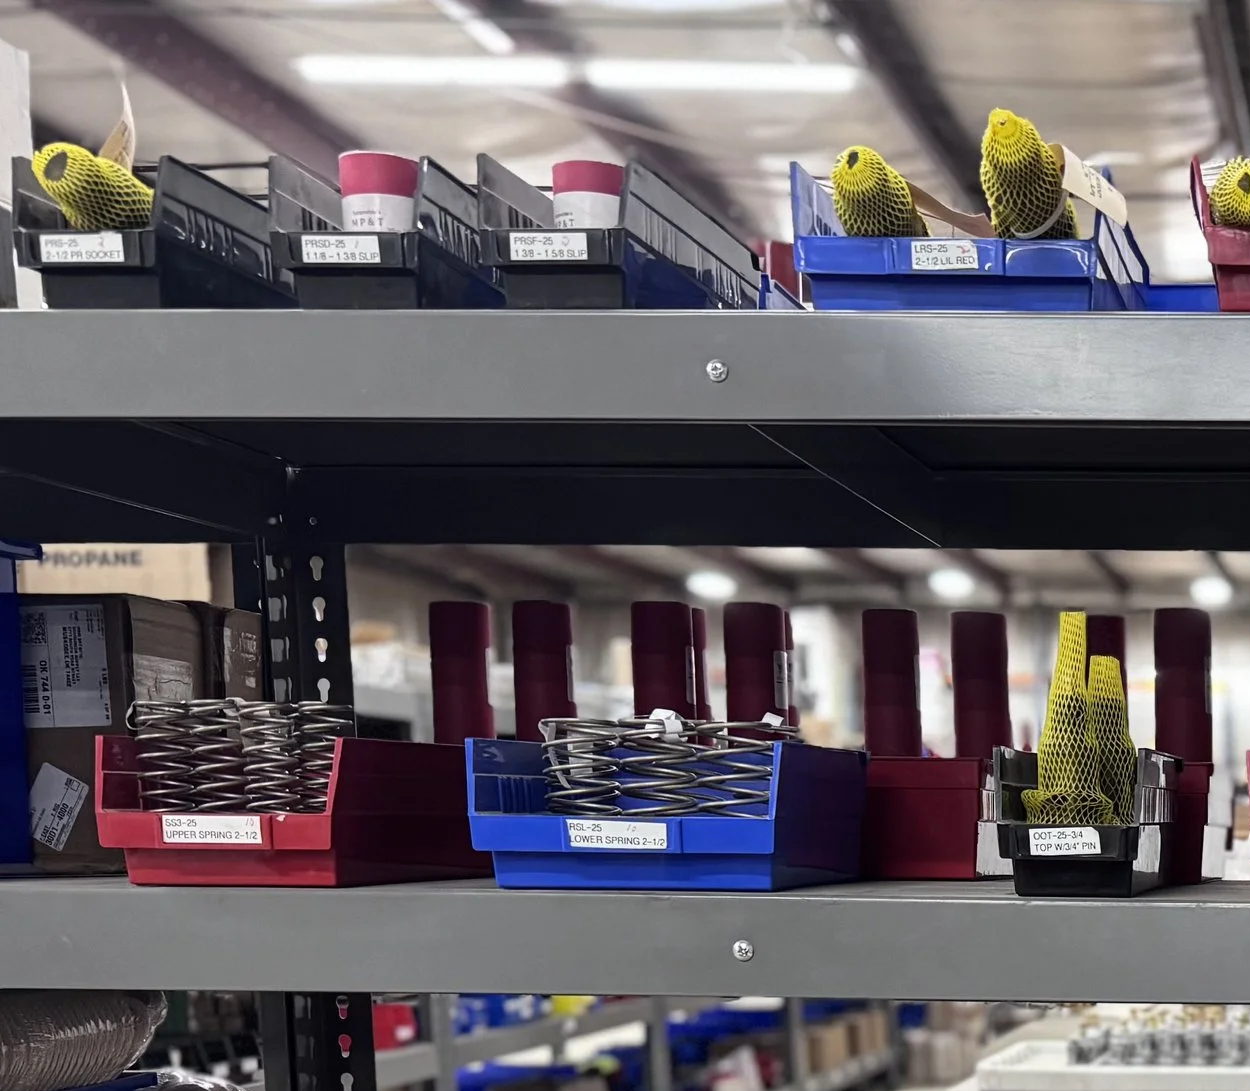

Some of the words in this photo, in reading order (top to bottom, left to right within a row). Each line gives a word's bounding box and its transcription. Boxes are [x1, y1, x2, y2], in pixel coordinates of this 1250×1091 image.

[44, 238, 79, 248] PRS-25
[304, 239, 346, 248] PRSD-25
[514, 236, 553, 246] PRSF-25
[566, 250, 586, 258] SLIP
[914, 244, 948, 254] LRS-25
[45, 251, 70, 259] 2-1/2
[70, 250, 83, 259] PR
[85, 250, 121, 259] SOCKET
[358, 252, 379, 261] SLIP
[915, 256, 939, 266] 2-1/2
[956, 256, 975, 265] RED
[38, 547, 143, 568] PROPANE
[165, 818, 197, 827] SS3-25
[567, 823, 602, 832] RSL-25
[165, 830, 197, 839] UPPER
[198, 830, 233, 839] SPRING
[234, 831, 258, 840] 2-1/2
[1033, 831, 1083, 840] OOT-25-3/4
[571, 835, 603, 844] LOWER
[604, 835, 641, 845] SPRING
[642, 837, 665, 847] 2-1/2
[1034, 843, 1052, 852] TOP
[1082, 842, 1096, 850] PIN
